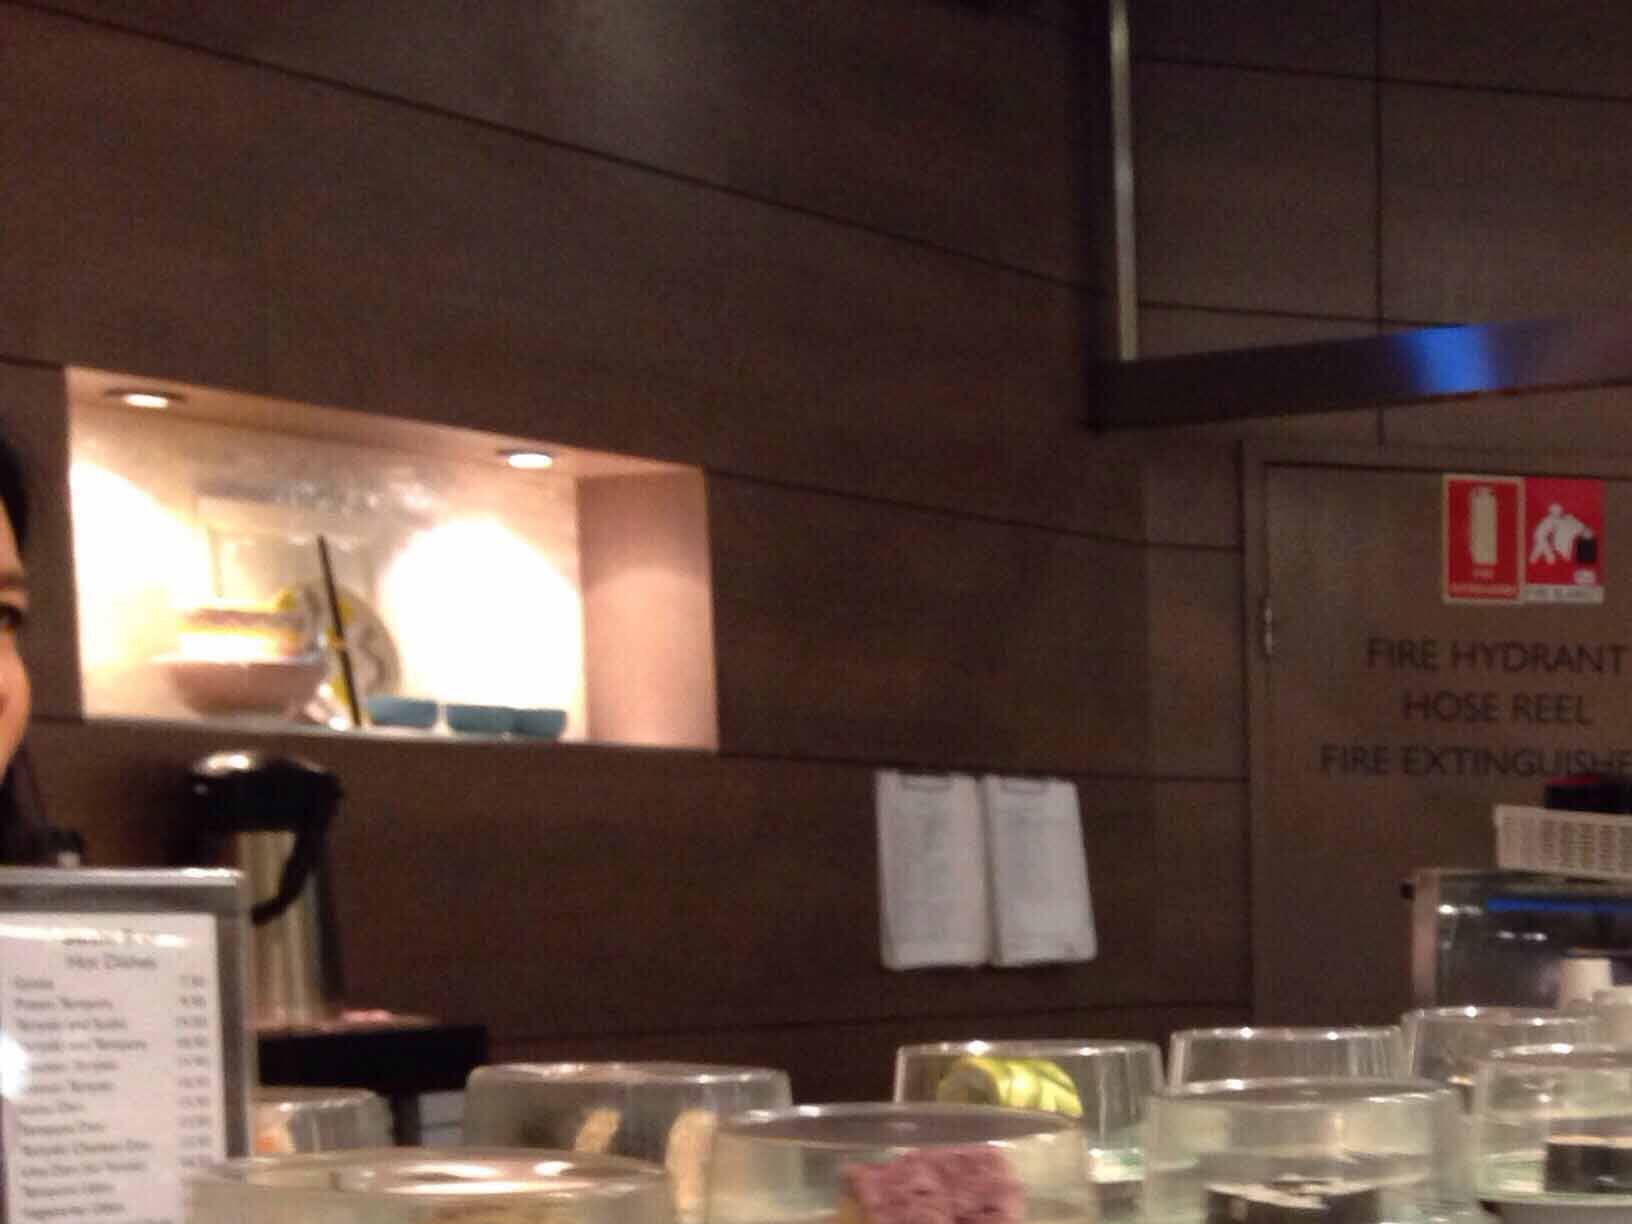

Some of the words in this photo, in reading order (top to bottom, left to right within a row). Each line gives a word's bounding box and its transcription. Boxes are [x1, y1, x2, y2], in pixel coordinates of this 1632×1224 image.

[1367, 638, 1438, 670] FIRE
[1451, 641, 1628, 674] HYDRANT
[1403, 692, 1499, 722] HOSE
[1512, 694, 1592, 725] REEL
[1321, 746, 1391, 777] FIRE
